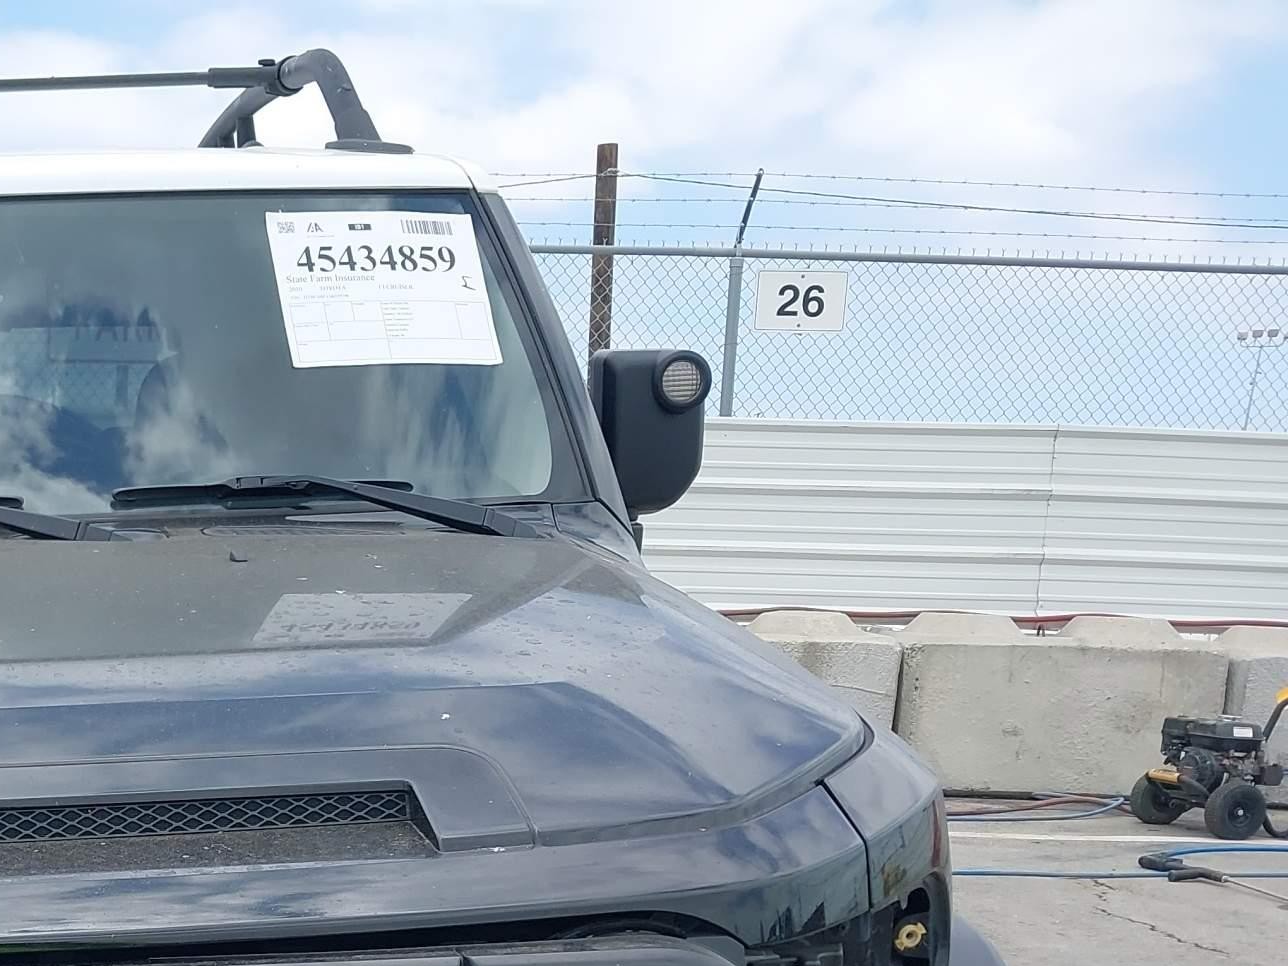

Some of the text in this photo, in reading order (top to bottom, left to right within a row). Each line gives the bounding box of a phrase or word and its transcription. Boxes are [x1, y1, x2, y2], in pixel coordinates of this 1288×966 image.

[297, 245, 456, 273] 45434859
[285, 274, 307, 283] State
[335, 273, 376, 283] Insurance
[776, 284, 825, 317] 26
